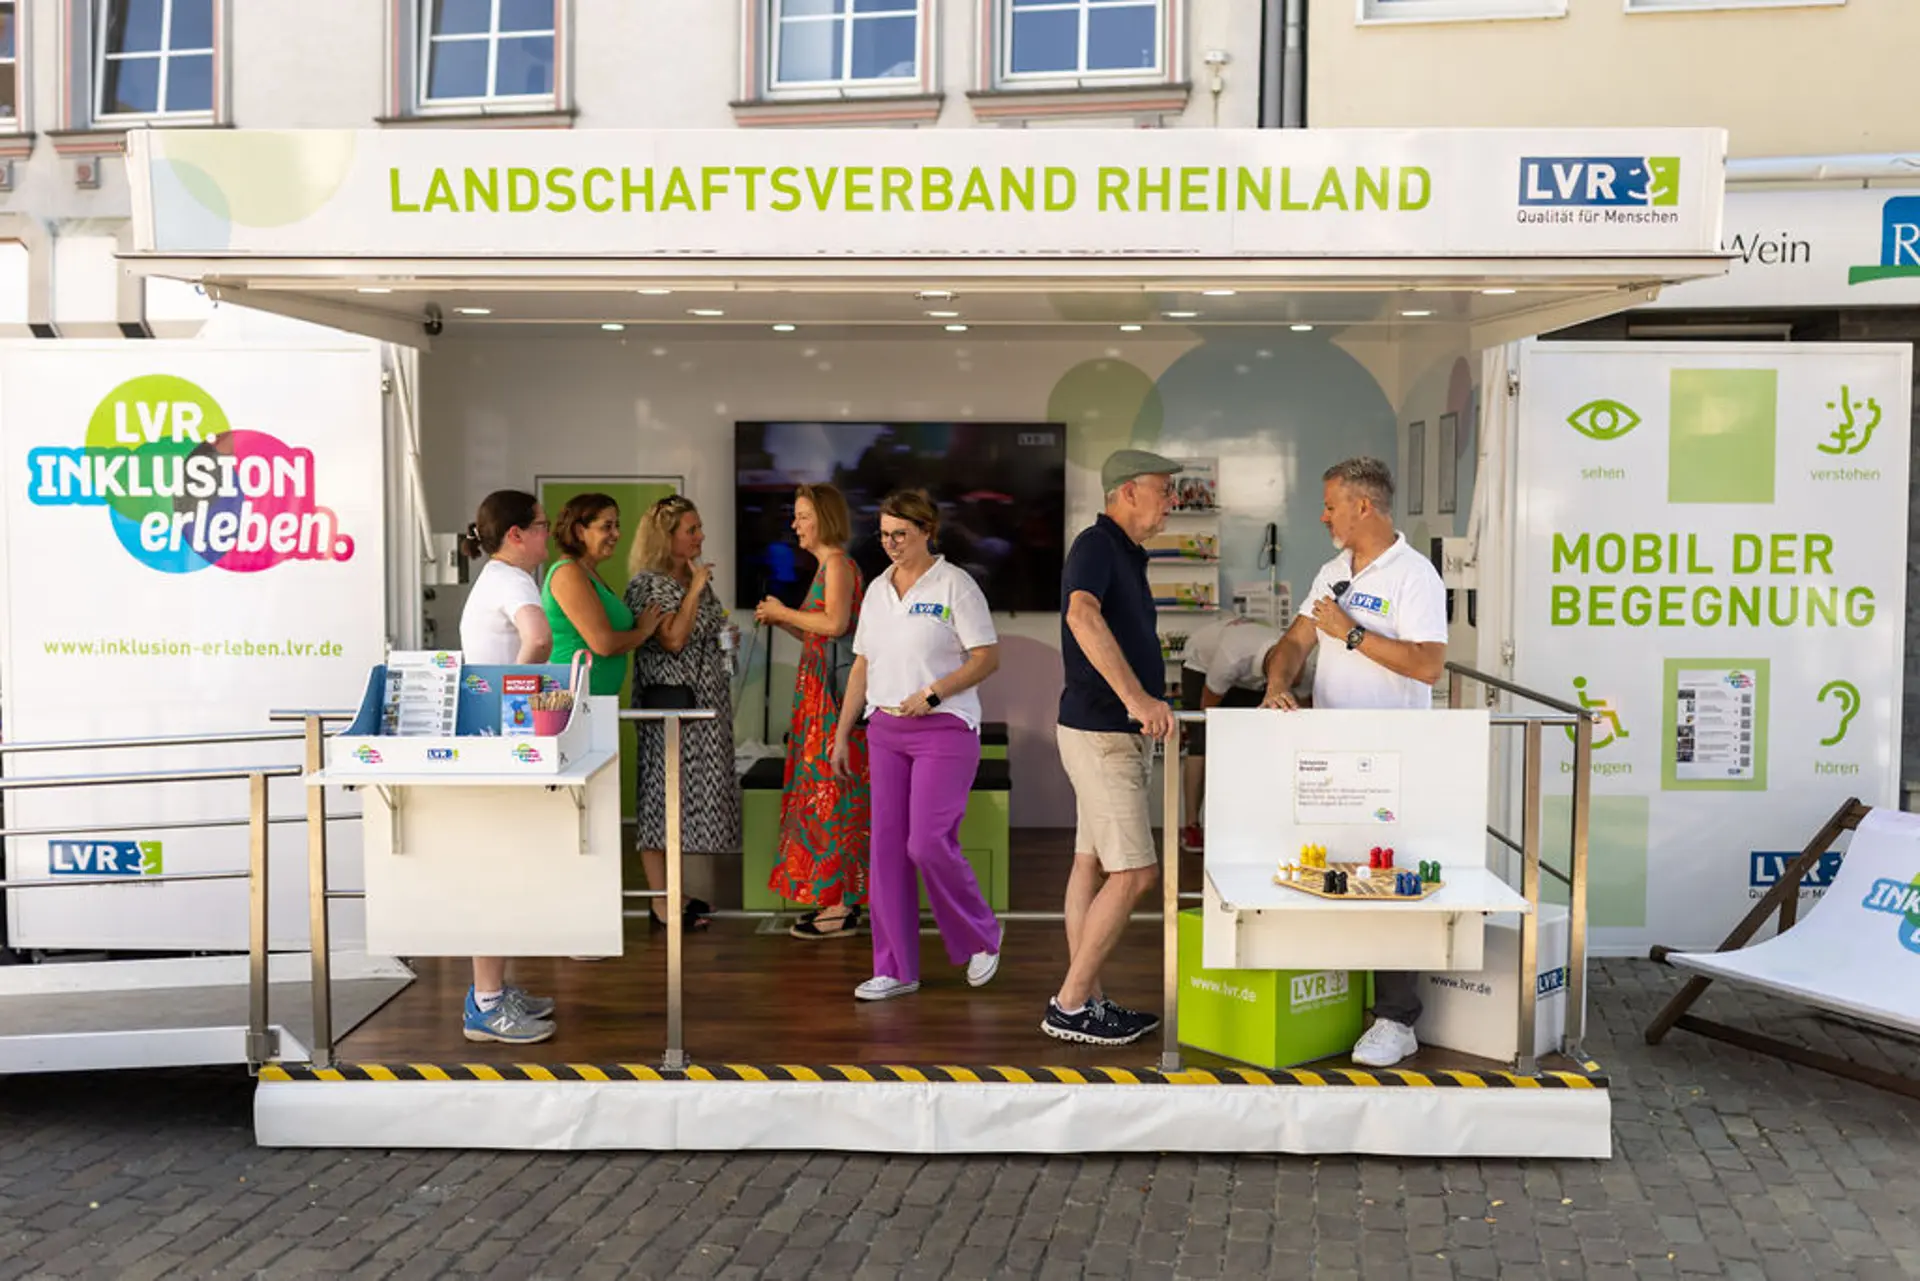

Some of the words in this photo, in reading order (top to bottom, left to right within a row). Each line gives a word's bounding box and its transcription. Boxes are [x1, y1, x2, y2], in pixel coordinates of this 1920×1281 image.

[389, 166, 1077, 212] LANDSCHAFTSVERBAND
[1098, 165, 1432, 212] RHEINLAND
[1527, 163, 1616, 199] LVR
[1517, 209, 1574, 224] Qualität
[1578, 209, 1600, 223] für
[1604, 209, 1679, 224] Menschen
[1721, 232, 1810, 265] Wein
[115, 401, 216, 443] LVR.
[36, 455, 306, 497] INKLUSION
[1580, 466, 1626, 481] sehen
[1809, 466, 1881, 482] verstehen
[140, 502, 350, 553] erleben.
[1552, 532, 1714, 575] MOBIL
[1732, 532, 1834, 575] DER
[1550, 585, 1876, 627] BEGEGNUNG
[44, 637, 343, 657] www.inklusion-erleben.lvr.de
[1815, 760, 1859, 775] hören
[53, 844, 118, 870] LVR
[1190, 975, 1257, 1003] www.lvr.de
[1293, 975, 1327, 1001] LVR
[1429, 975, 1492, 995] www.lvr.de
